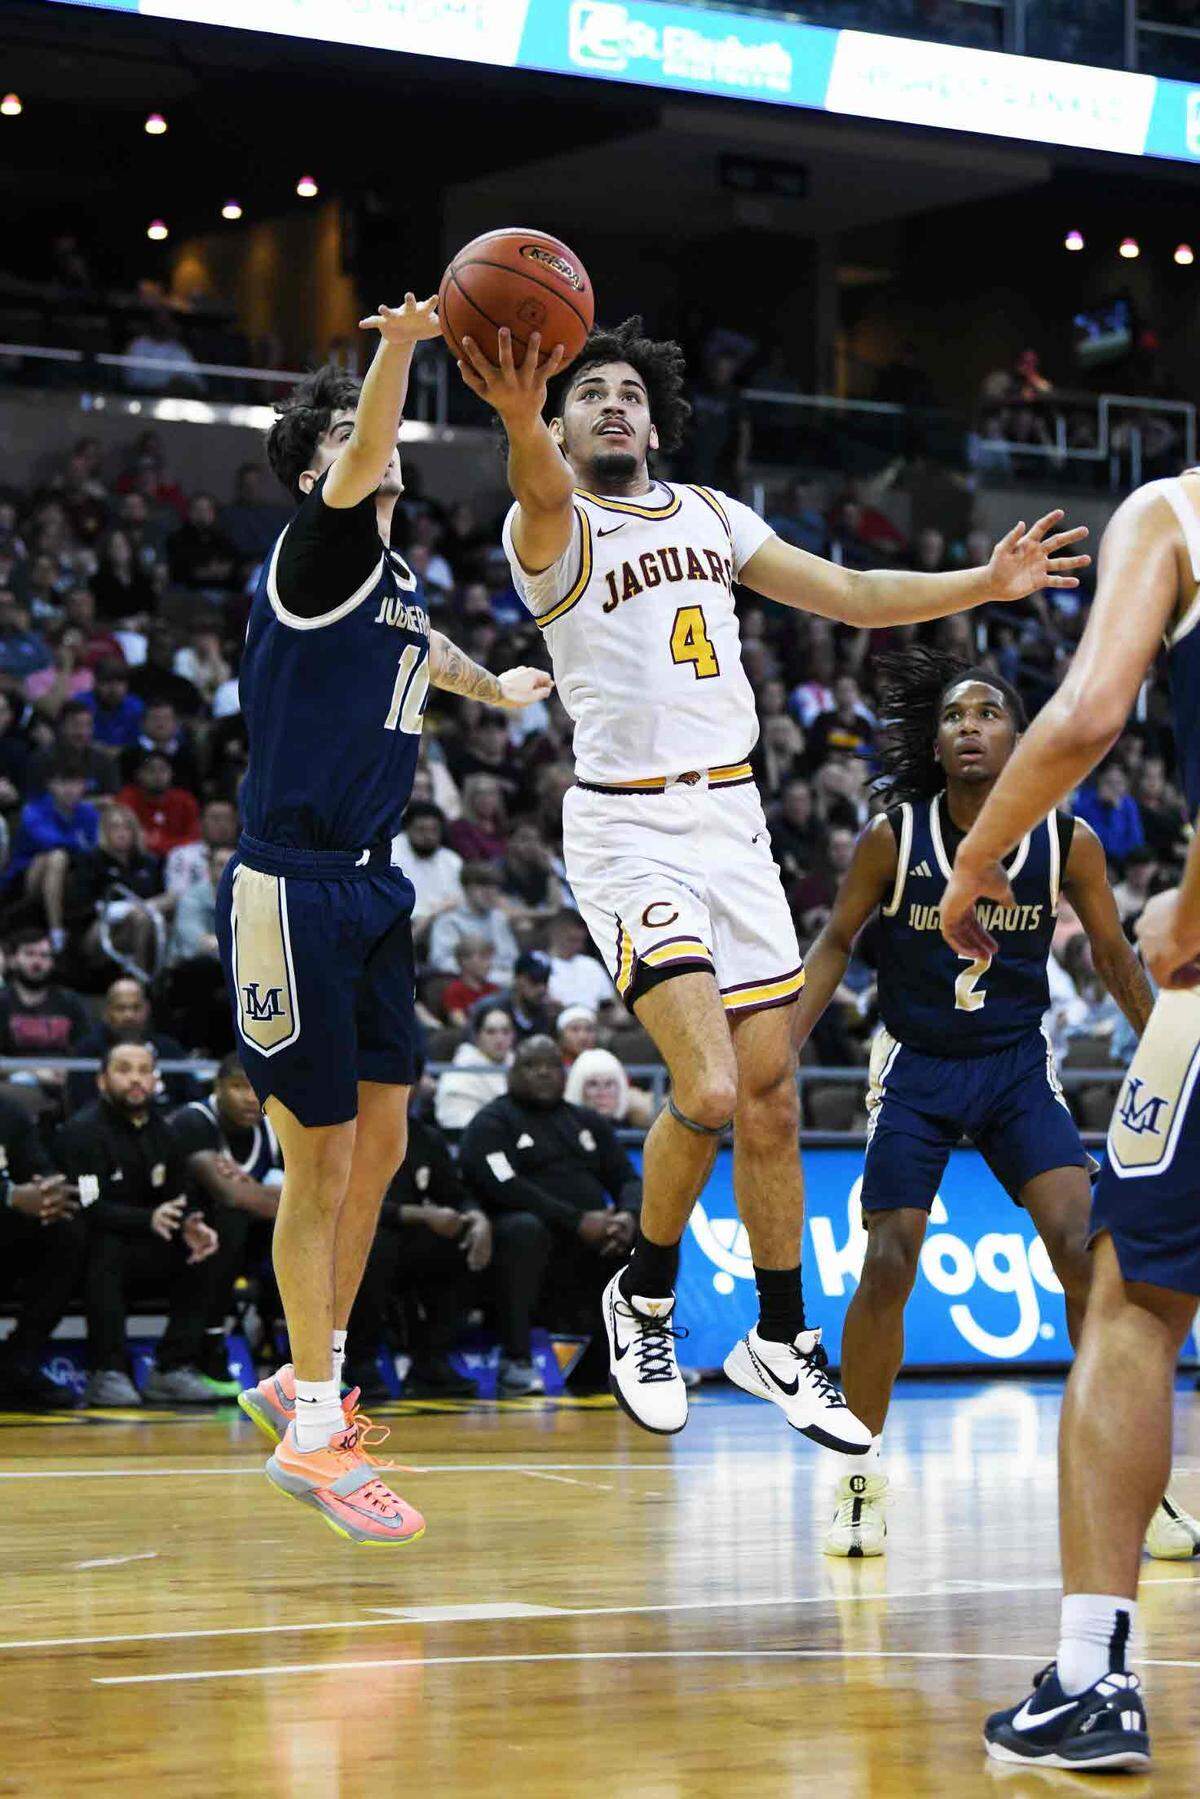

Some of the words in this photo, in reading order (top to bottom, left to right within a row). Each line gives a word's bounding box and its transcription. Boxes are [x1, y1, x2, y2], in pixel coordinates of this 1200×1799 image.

[669, 605, 720, 680] 4
[642, 901, 679, 928] C
[908, 903, 1043, 931] JUGNAUTS
[954, 952, 987, 1012] 2
